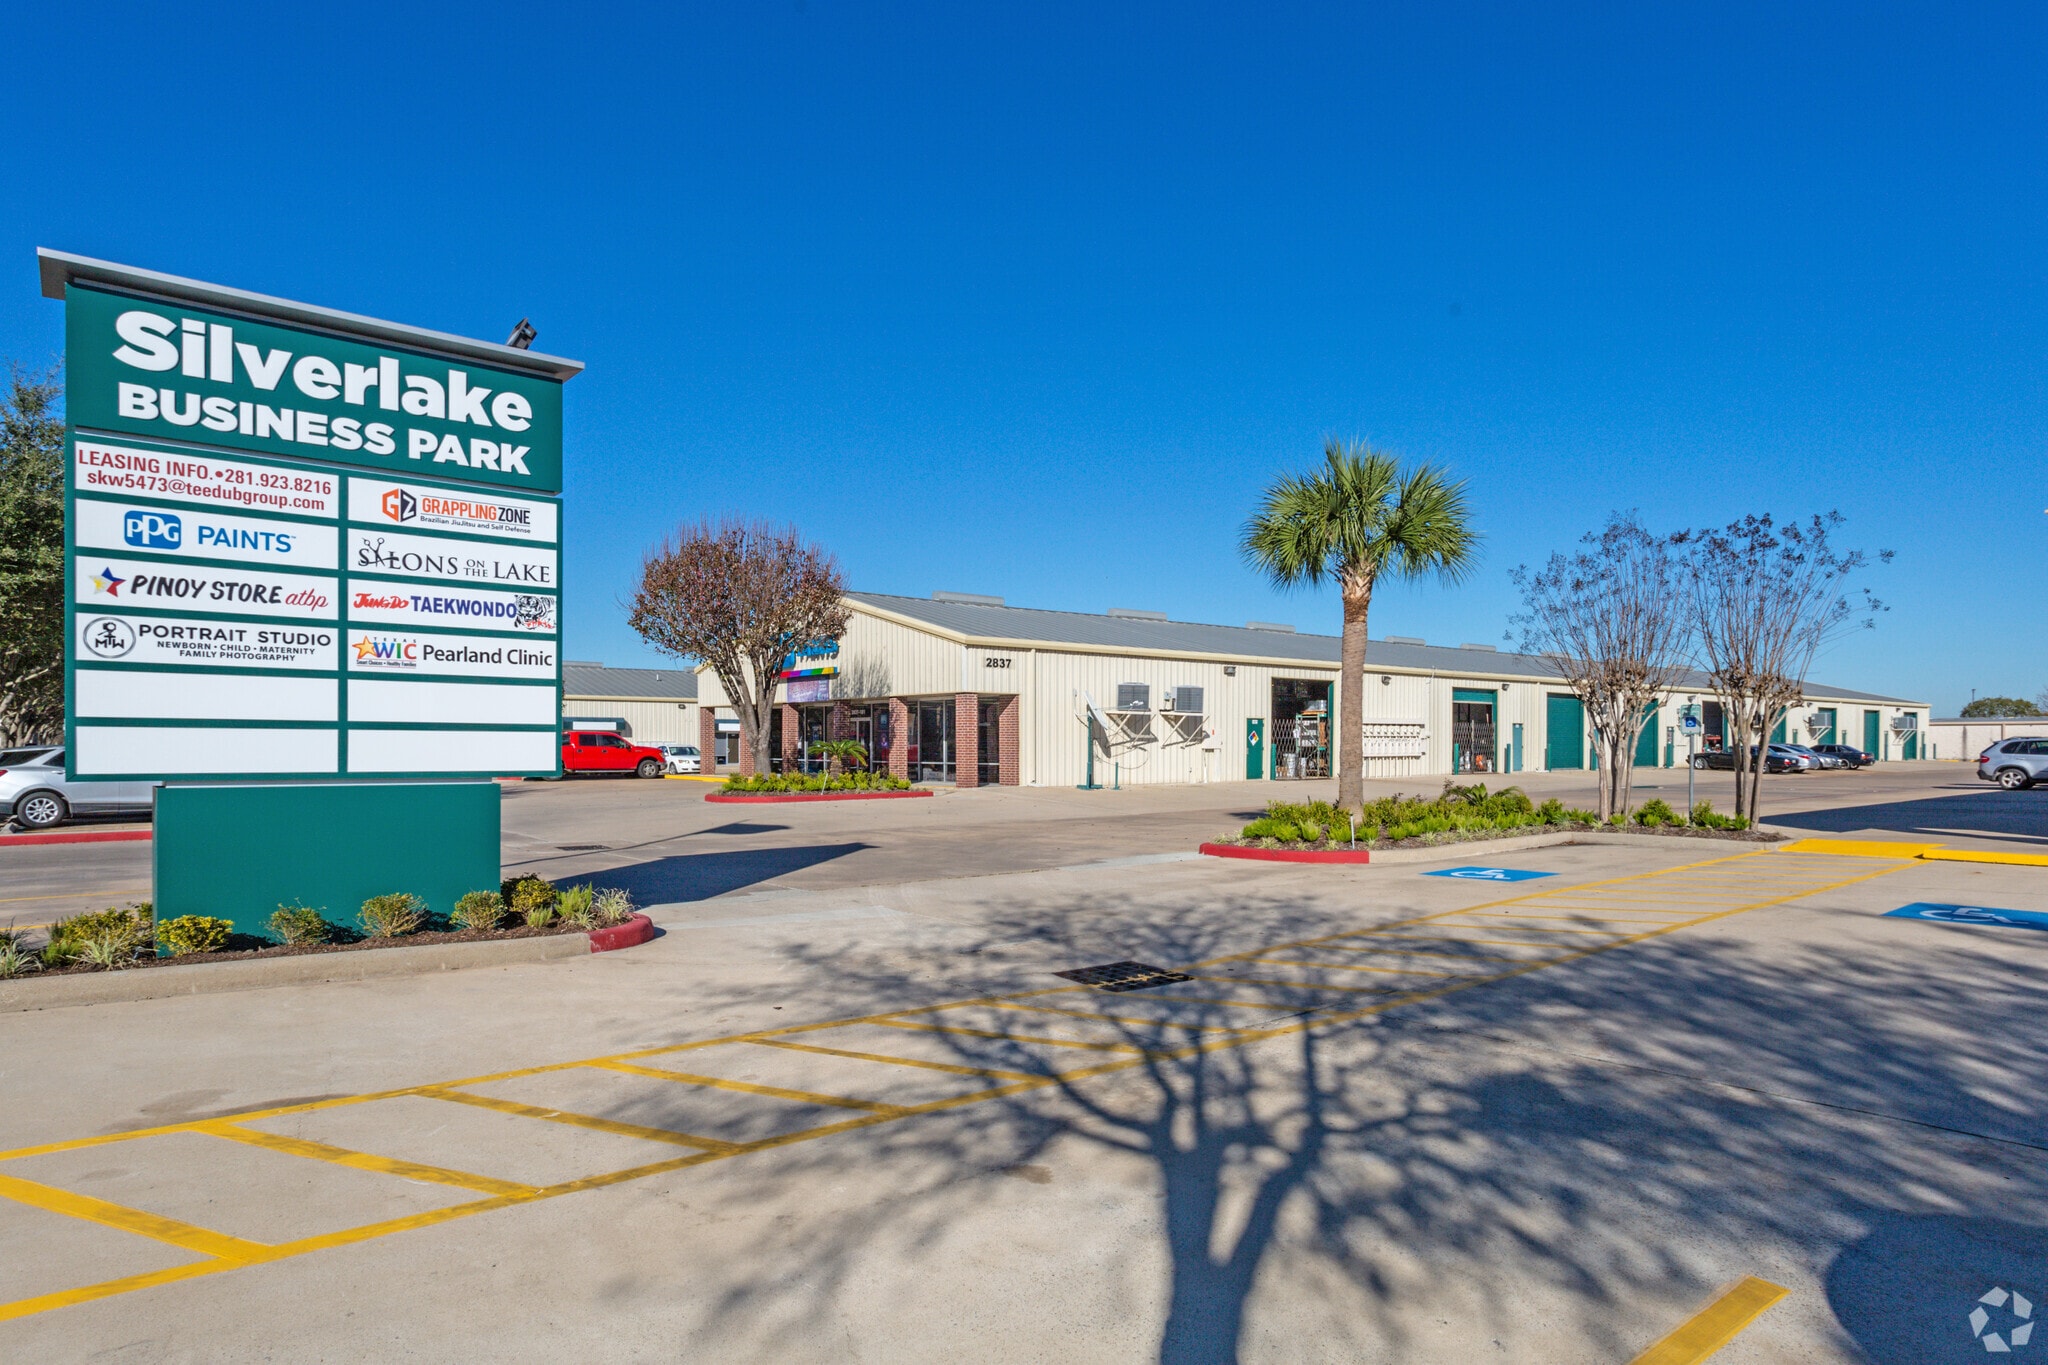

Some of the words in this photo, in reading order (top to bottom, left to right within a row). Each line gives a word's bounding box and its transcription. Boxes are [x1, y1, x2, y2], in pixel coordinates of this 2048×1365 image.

[112, 310, 533, 432] Silverlake
[118, 382, 396, 455] BUSINESS
[408, 429, 531, 475] PARK
[79, 449, 160, 473] LEASING
[87, 470, 325, 510] skw5473@teedubgroup.com
[126, 515, 180, 544] PPG
[420, 515, 450, 525] Brazilian
[505, 525, 530, 534] Defense
[463, 567, 488, 578] THE
[466, 559, 485, 569] ON
[494, 561, 550, 583] LAKE
[130, 574, 207, 599] PINOY
[210, 580, 283, 604] STORE
[285, 588, 329, 611] atbp
[410, 595, 517, 618] TAEKWONDO
[138, 624, 247, 642] PORTRAIT
[257, 631, 331, 646] STUDIO
[157, 641, 211, 650] NEWBORN
[220, 644, 251, 652] CHILD
[259, 646, 315, 655] MATERNITY
[179, 649, 217, 659] FAMILY
[219, 652, 296, 662] PHOTOGRAPHY
[373, 641, 417, 660] WIC
[423, 644, 501, 664] Pearland
[507, 649, 553, 666] Clinic
[986, 657, 1012, 669] 2837
